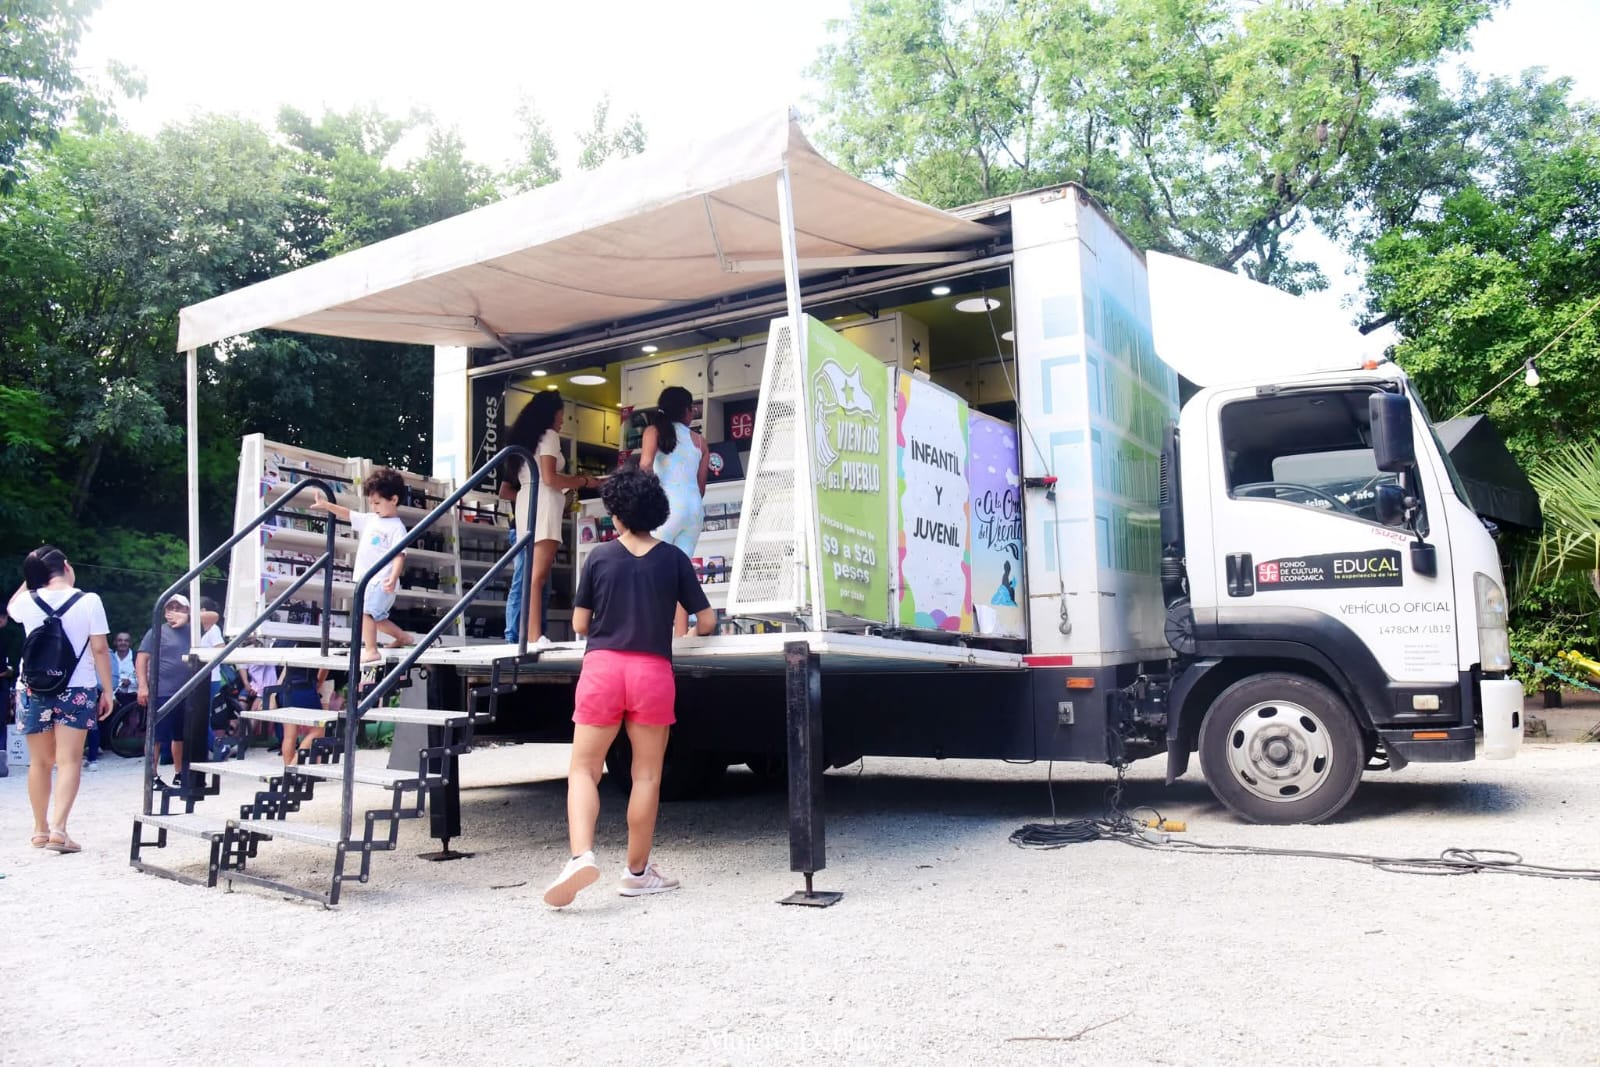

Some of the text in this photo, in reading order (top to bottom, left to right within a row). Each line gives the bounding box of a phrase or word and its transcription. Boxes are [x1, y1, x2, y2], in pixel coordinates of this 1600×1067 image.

[828, 460, 880, 491] DEL PUEBLO
[935, 485, 943, 506] Y
[1371, 527, 1408, 542] ISUZU
[842, 544, 852, 559] a
[833, 561, 870, 584] pesos
[1280, 561, 1306, 569] FONDO
[1291, 567, 1324, 575] CULTURA
[1333, 556, 1399, 574] EDUCAL
[1339, 600, 1451, 615] VEHÍCULO OFICIAL
